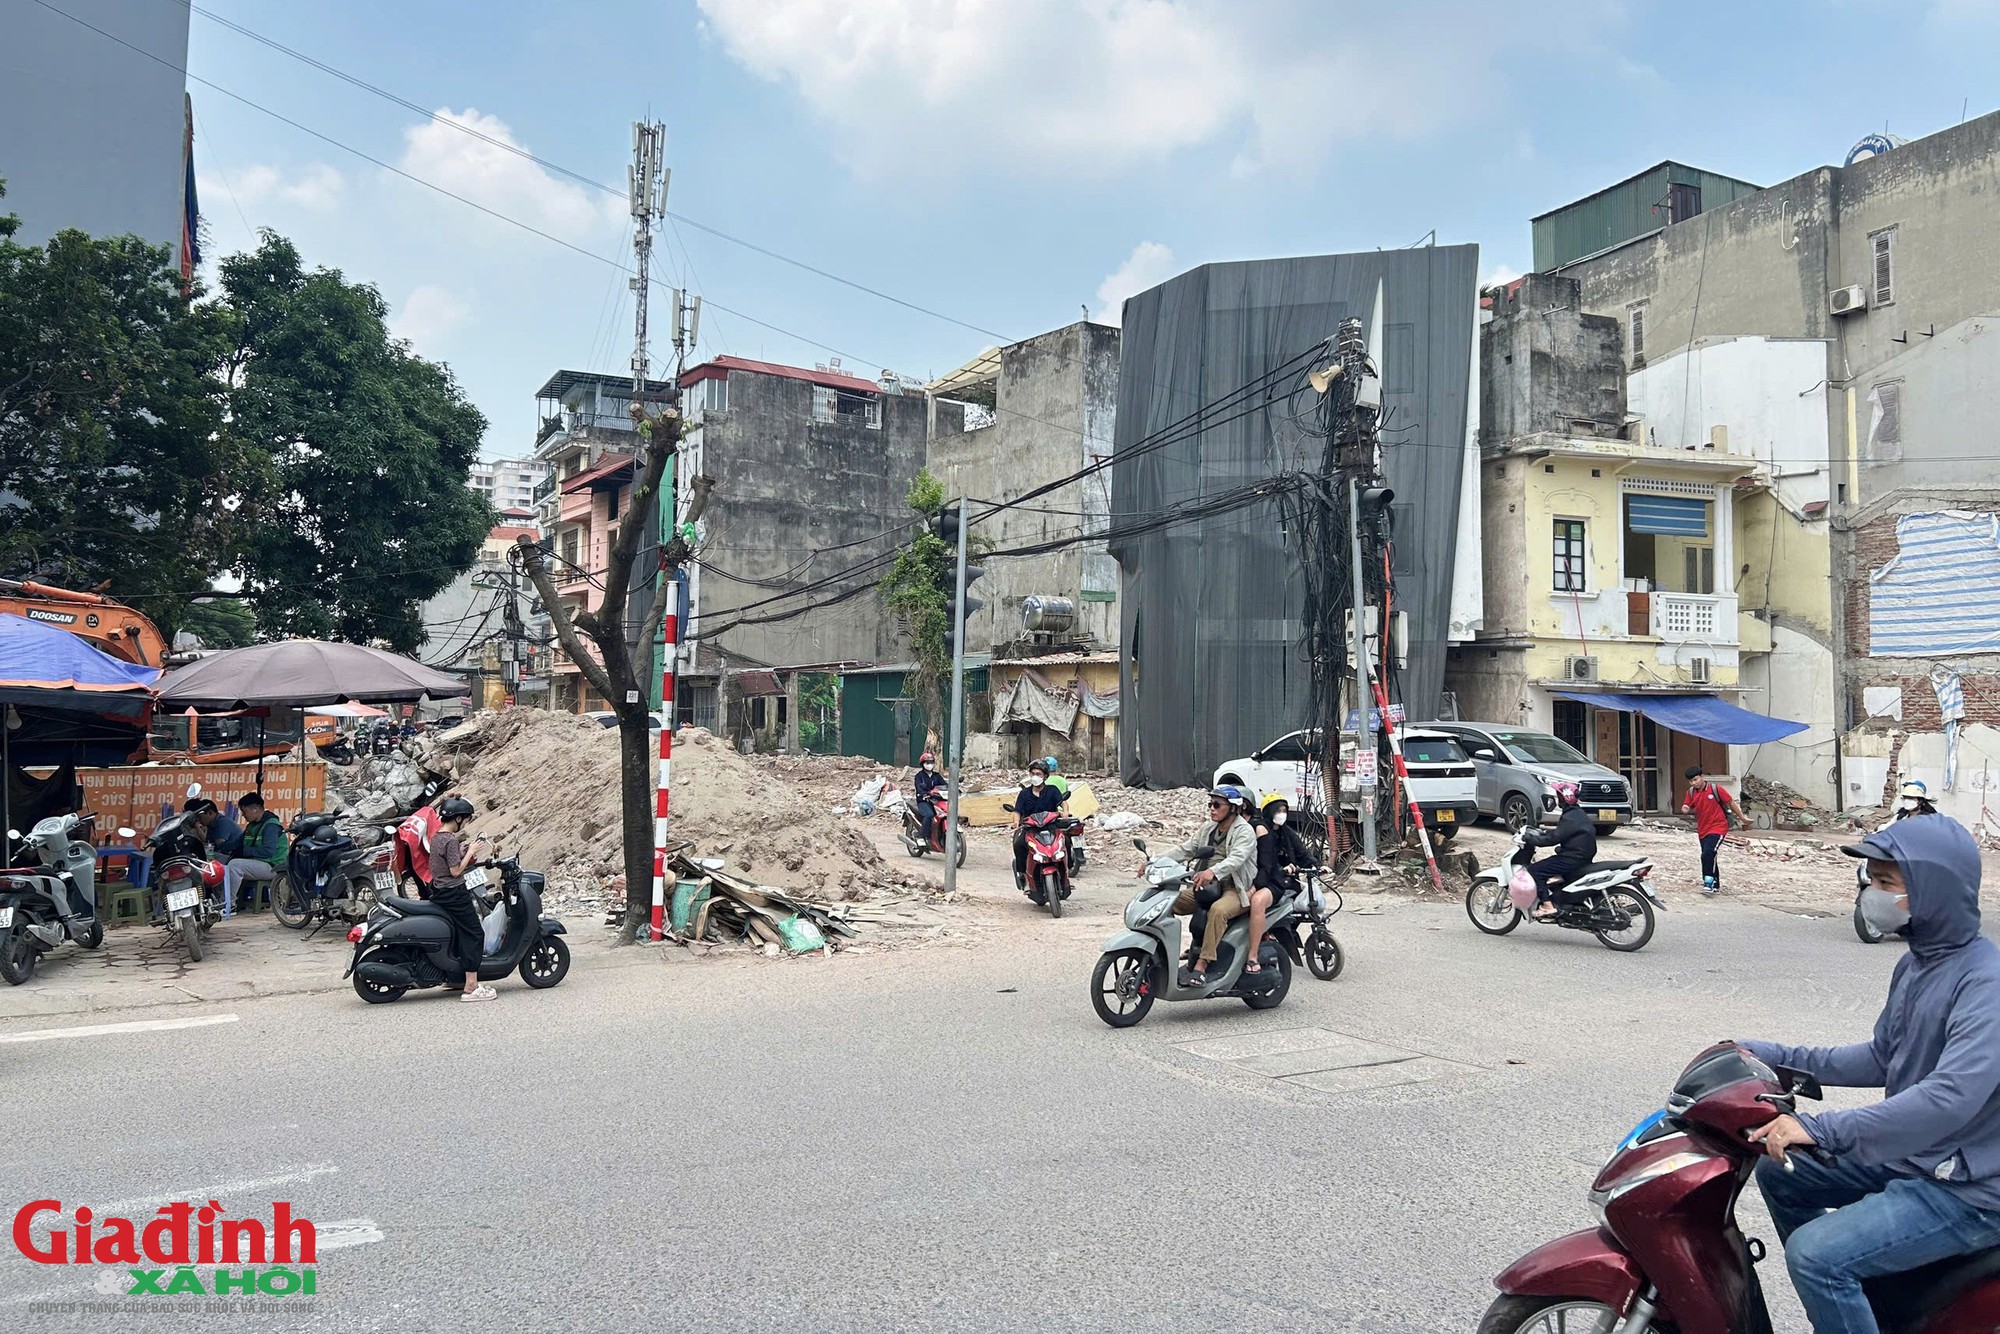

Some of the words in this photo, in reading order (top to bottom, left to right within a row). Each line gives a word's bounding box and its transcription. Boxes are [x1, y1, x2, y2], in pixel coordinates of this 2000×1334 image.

[29, 610, 74, 623] DOOSAN
[205, 770, 246, 787] PHÒNG
[267, 770, 288, 783] PIN
[277, 788, 292, 800] DA
